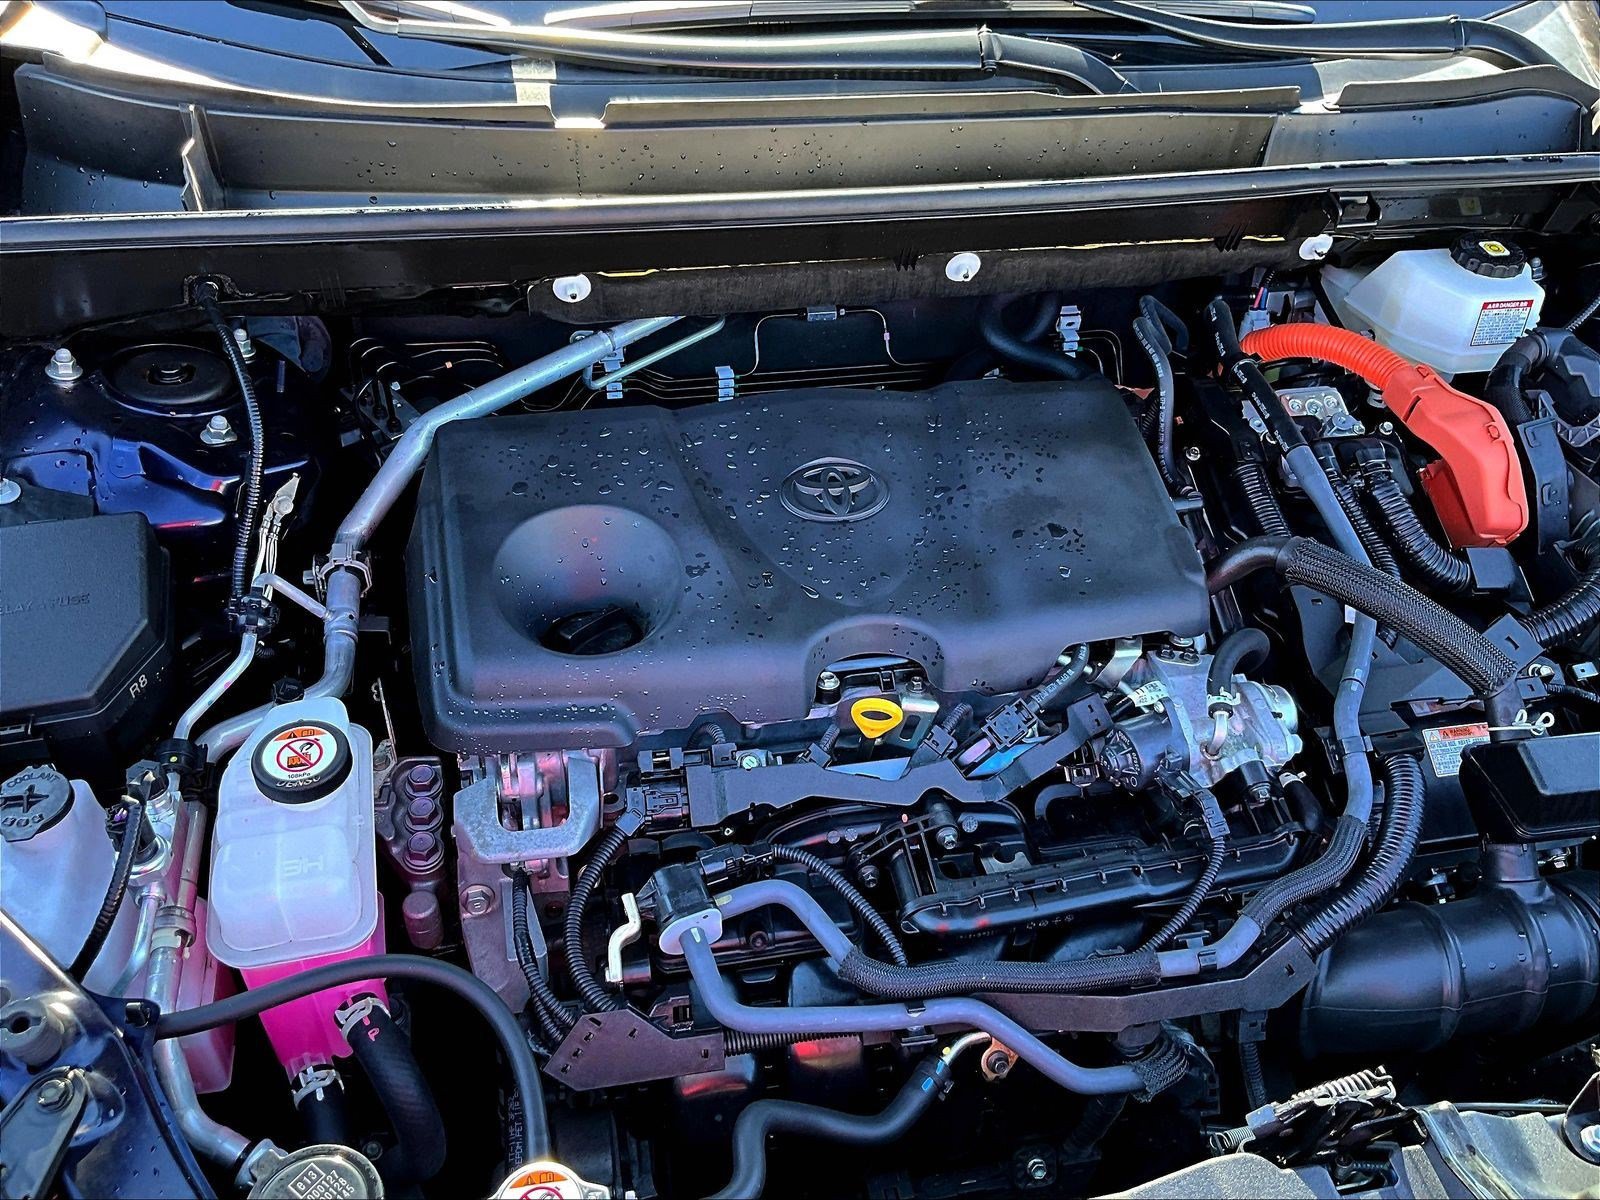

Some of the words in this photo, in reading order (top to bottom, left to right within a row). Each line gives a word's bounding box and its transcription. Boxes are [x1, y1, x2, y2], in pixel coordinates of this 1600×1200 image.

[128, 674, 149, 699] R8
[7, 772, 61, 788] COOLANT
[275, 775, 321, 789] DENSO
[367, 1027, 381, 1042] P
[296, 1170, 318, 1191] e13
